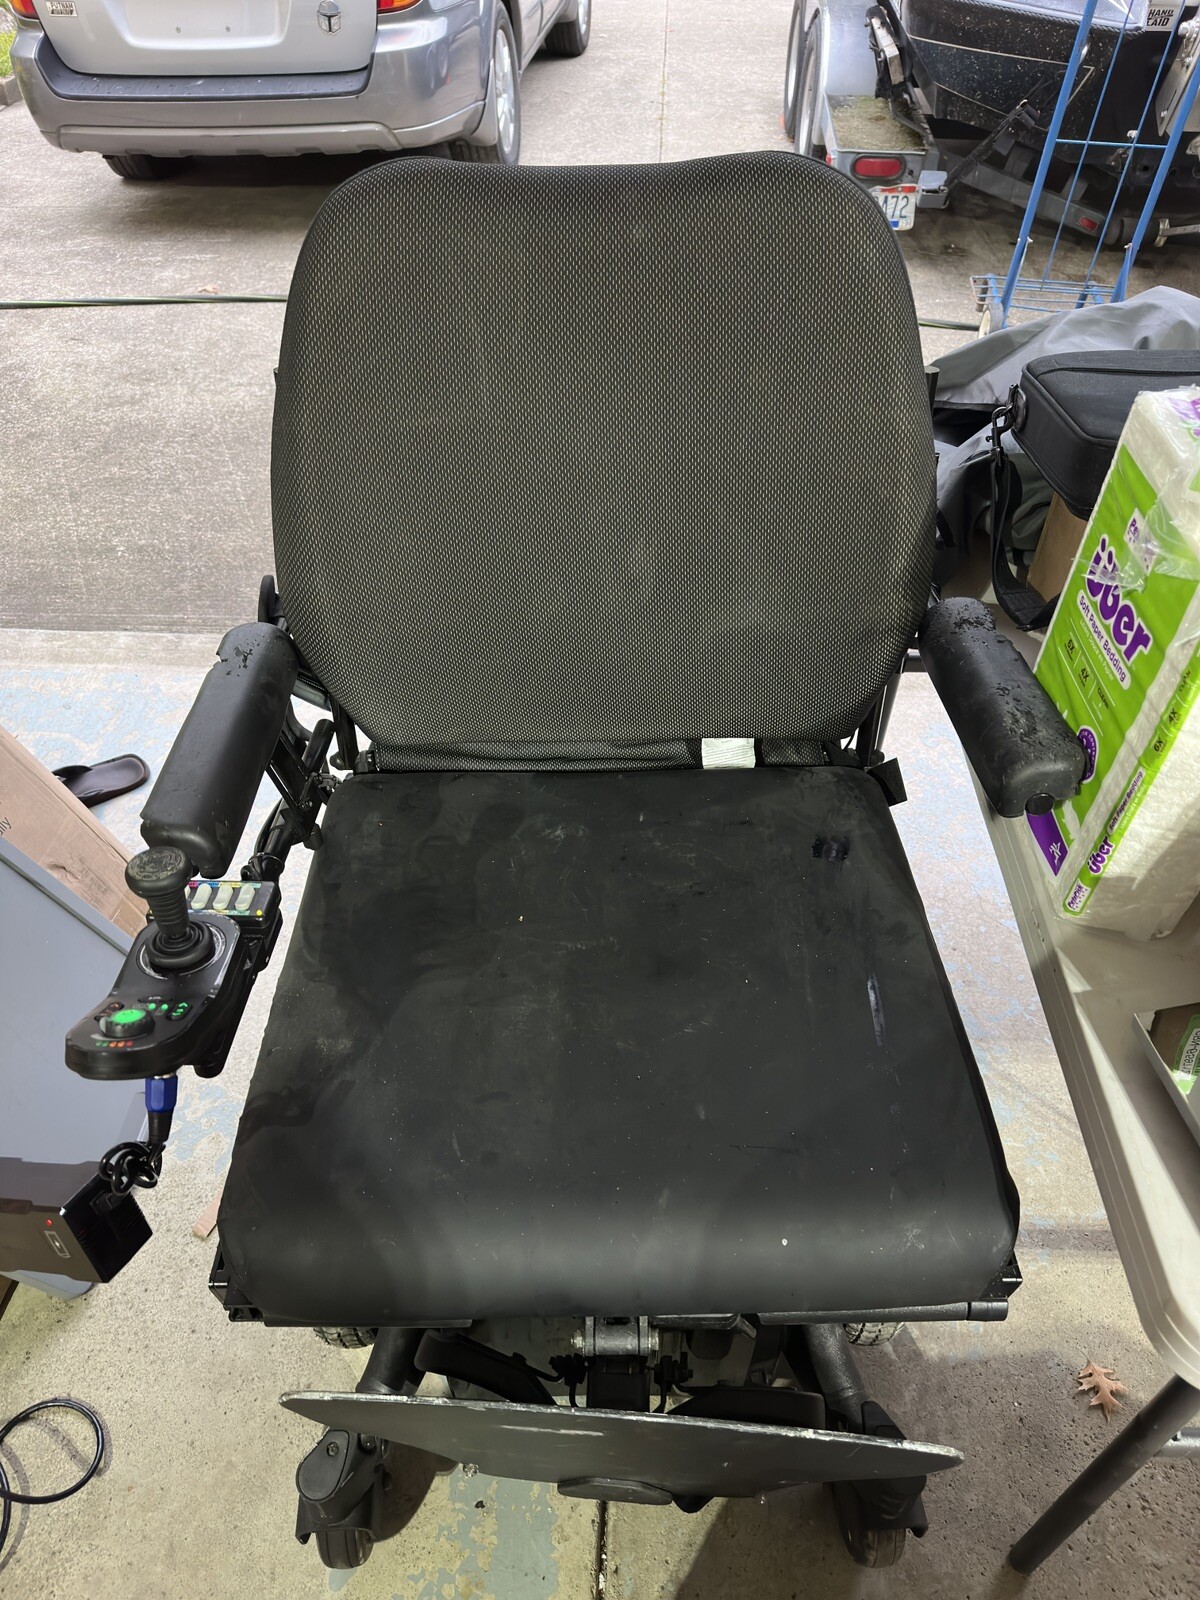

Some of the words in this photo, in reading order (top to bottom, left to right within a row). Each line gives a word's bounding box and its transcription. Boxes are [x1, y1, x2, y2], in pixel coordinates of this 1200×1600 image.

[1148, 9, 1174, 17] HAND
[1079, 595, 1090, 617] Soft
[1088, 614, 1104, 641] Paper
[1103, 639, 1127, 682] Bedding
[1116, 799, 1128, 817] Paper
